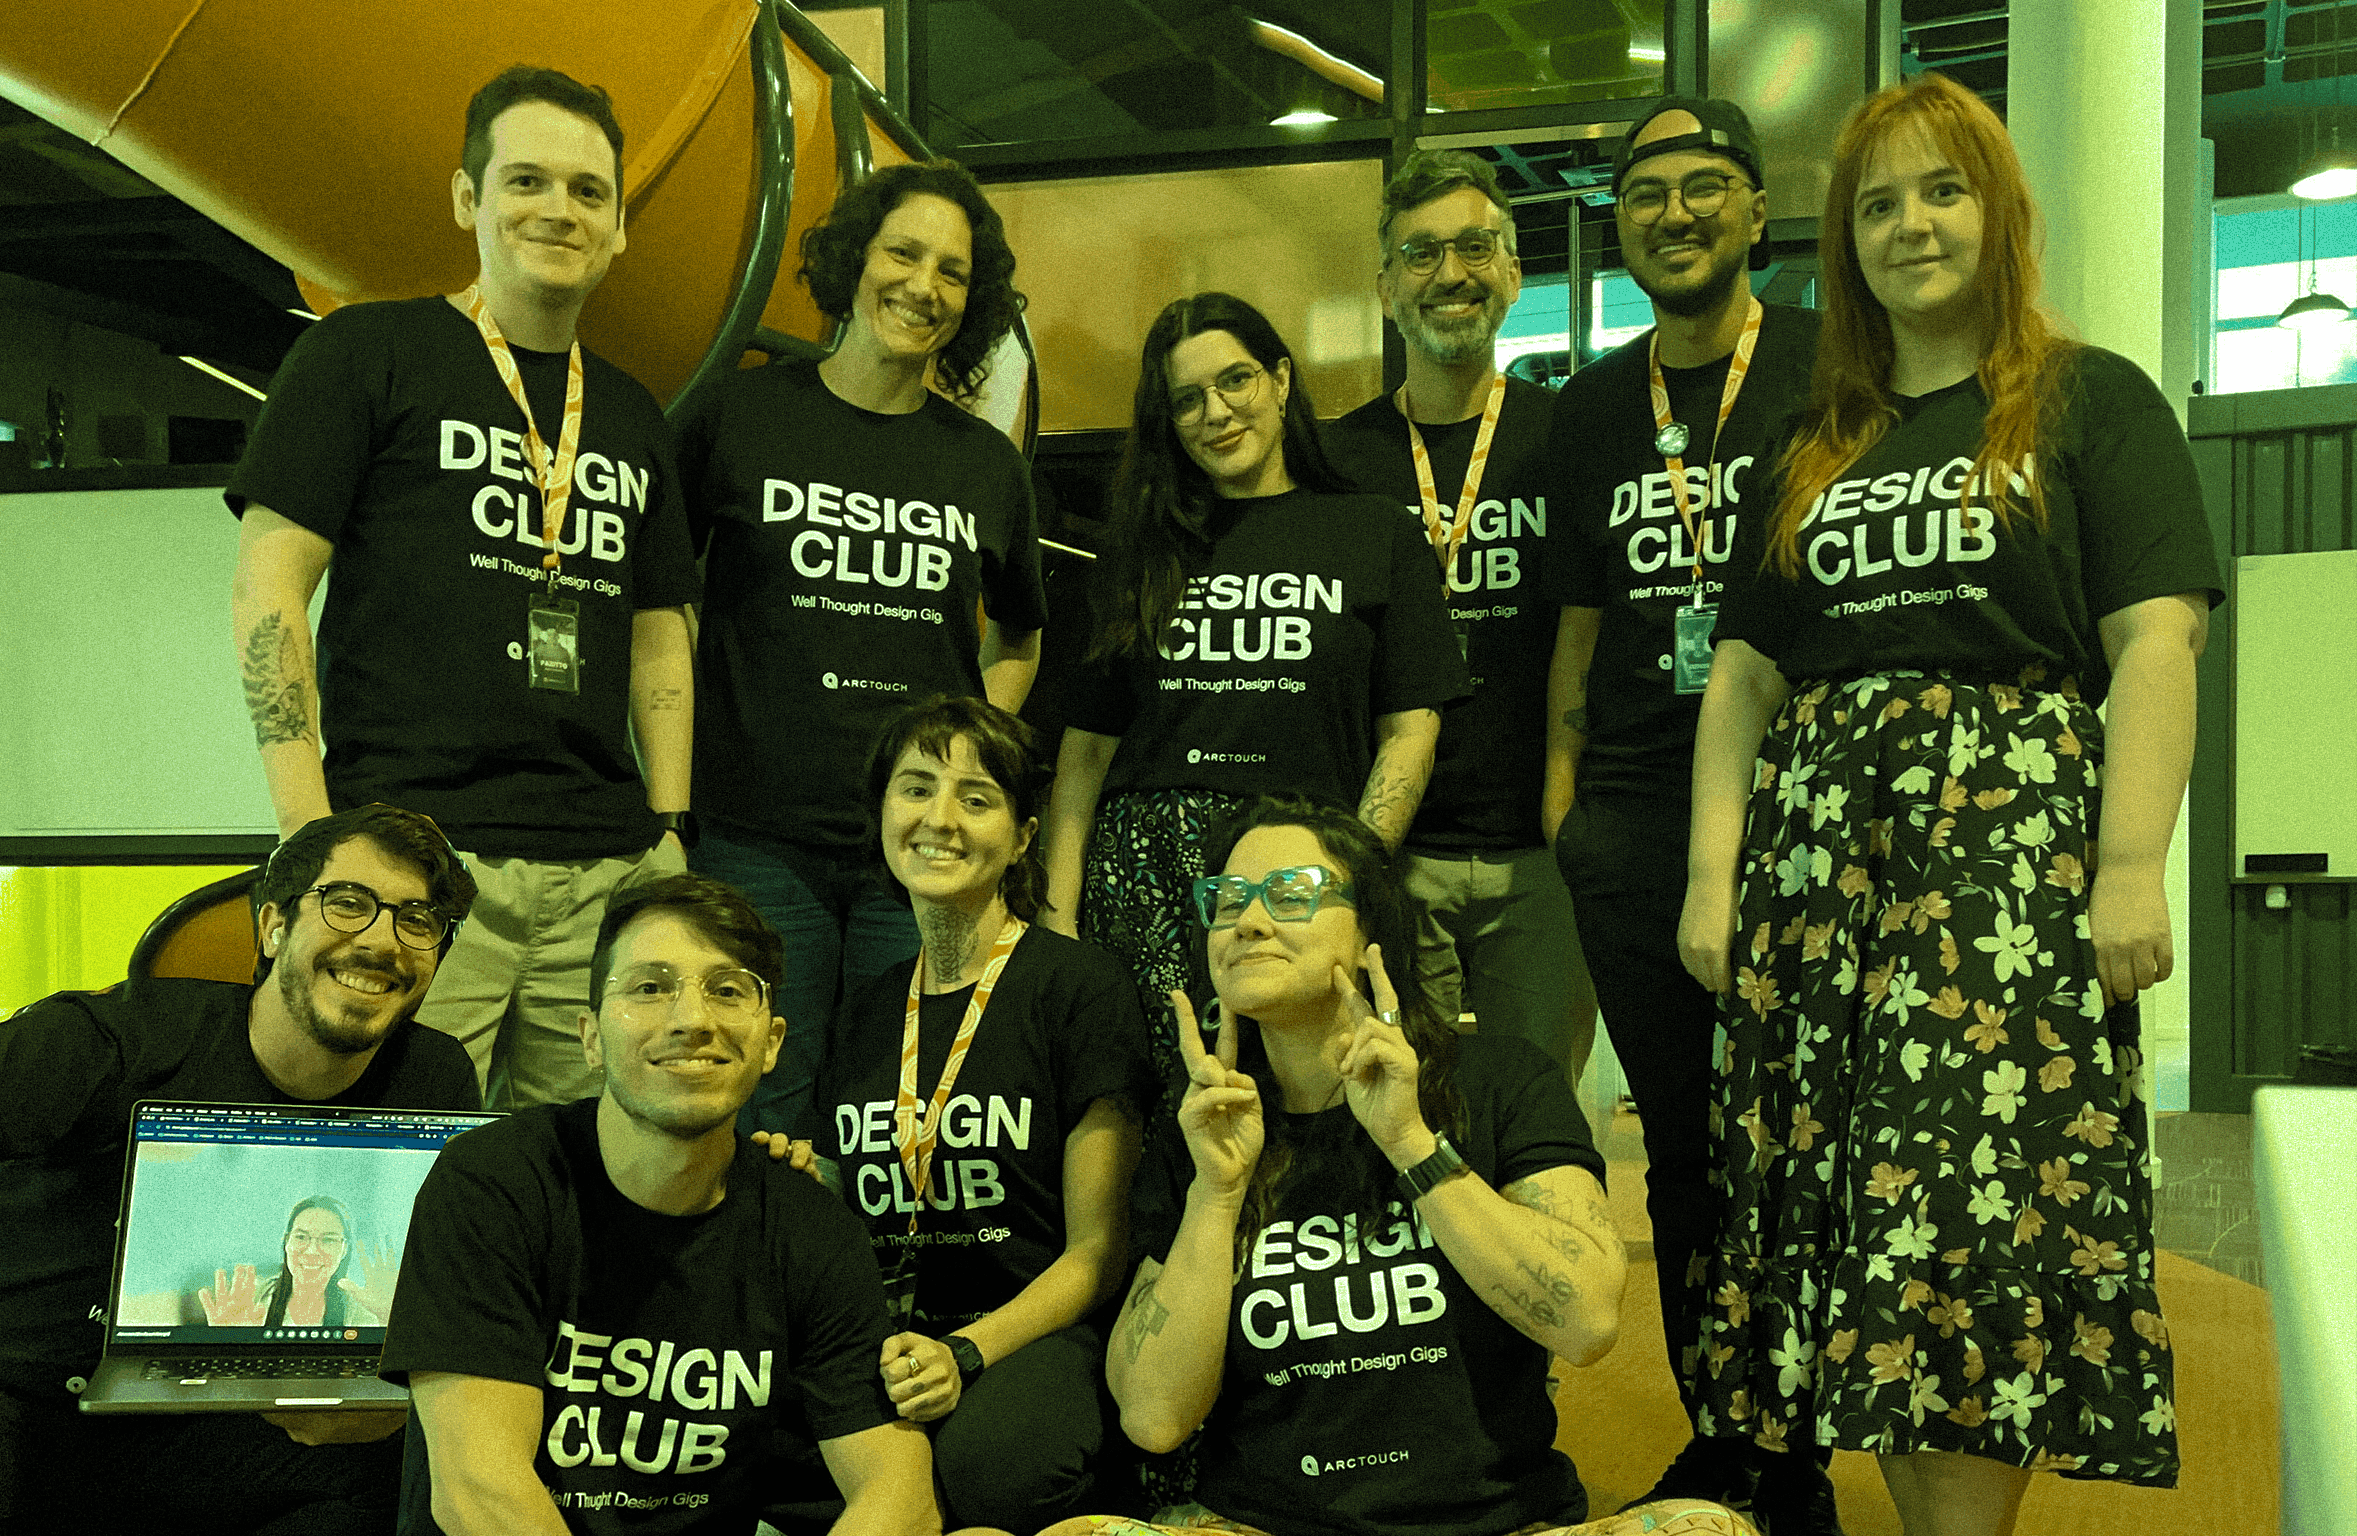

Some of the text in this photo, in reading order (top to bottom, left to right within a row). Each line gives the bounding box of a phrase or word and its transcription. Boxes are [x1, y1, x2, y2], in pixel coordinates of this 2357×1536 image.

[439, 419, 649, 514] DEGN
[470, 484, 627, 562] CLUB
[763, 478, 978, 552] DESIGN
[790, 530, 952, 591] CLUB
[1627, 514, 1737, 573] CLU
[1807, 506, 1997, 586] CLUB
[469, 553, 499, 570] Well
[593, 579, 622, 597] Gigs
[1449, 547, 1521, 593] UB
[791, 594, 944, 625] Well Thought Design Gig
[1177, 572, 1343, 614] ESIGN
[1451, 604, 1518, 621] Design Gigs
[1629, 587, 1653, 600] Well
[1841, 592, 1897, 615] Thought
[1900, 587, 1953, 605] Design
[1956, 584, 1988, 601] Gigs
[1156, 616, 1312, 662] CLUB
[841, 678, 908, 692] ARCTOUCH
[1158, 677, 1306, 694] Well Thought Design Gigs
[1202, 752, 1266, 763] ARCTOUCH
[835, 1094, 1032, 1155] DEGN
[857, 1158, 1006, 1217] CLUB
[869, 1235, 885, 1248] ell
[935, 1231, 975, 1246] Design
[978, 1226, 1011, 1243] Gigs
[1233, 1201, 1434, 1286] ESIG
[1240, 1263, 1447, 1349] CLUB
[1351, 1352, 1406, 1372] Design
[1410, 1346, 1448, 1364] Gigs
[547, 1404, 730, 1474] CLUB
[1324, 1450, 1409, 1472] ARCTOUCH
[550, 1490, 572, 1508] ell
[614, 1491, 668, 1511] Design
[672, 1491, 709, 1509] Gigs
